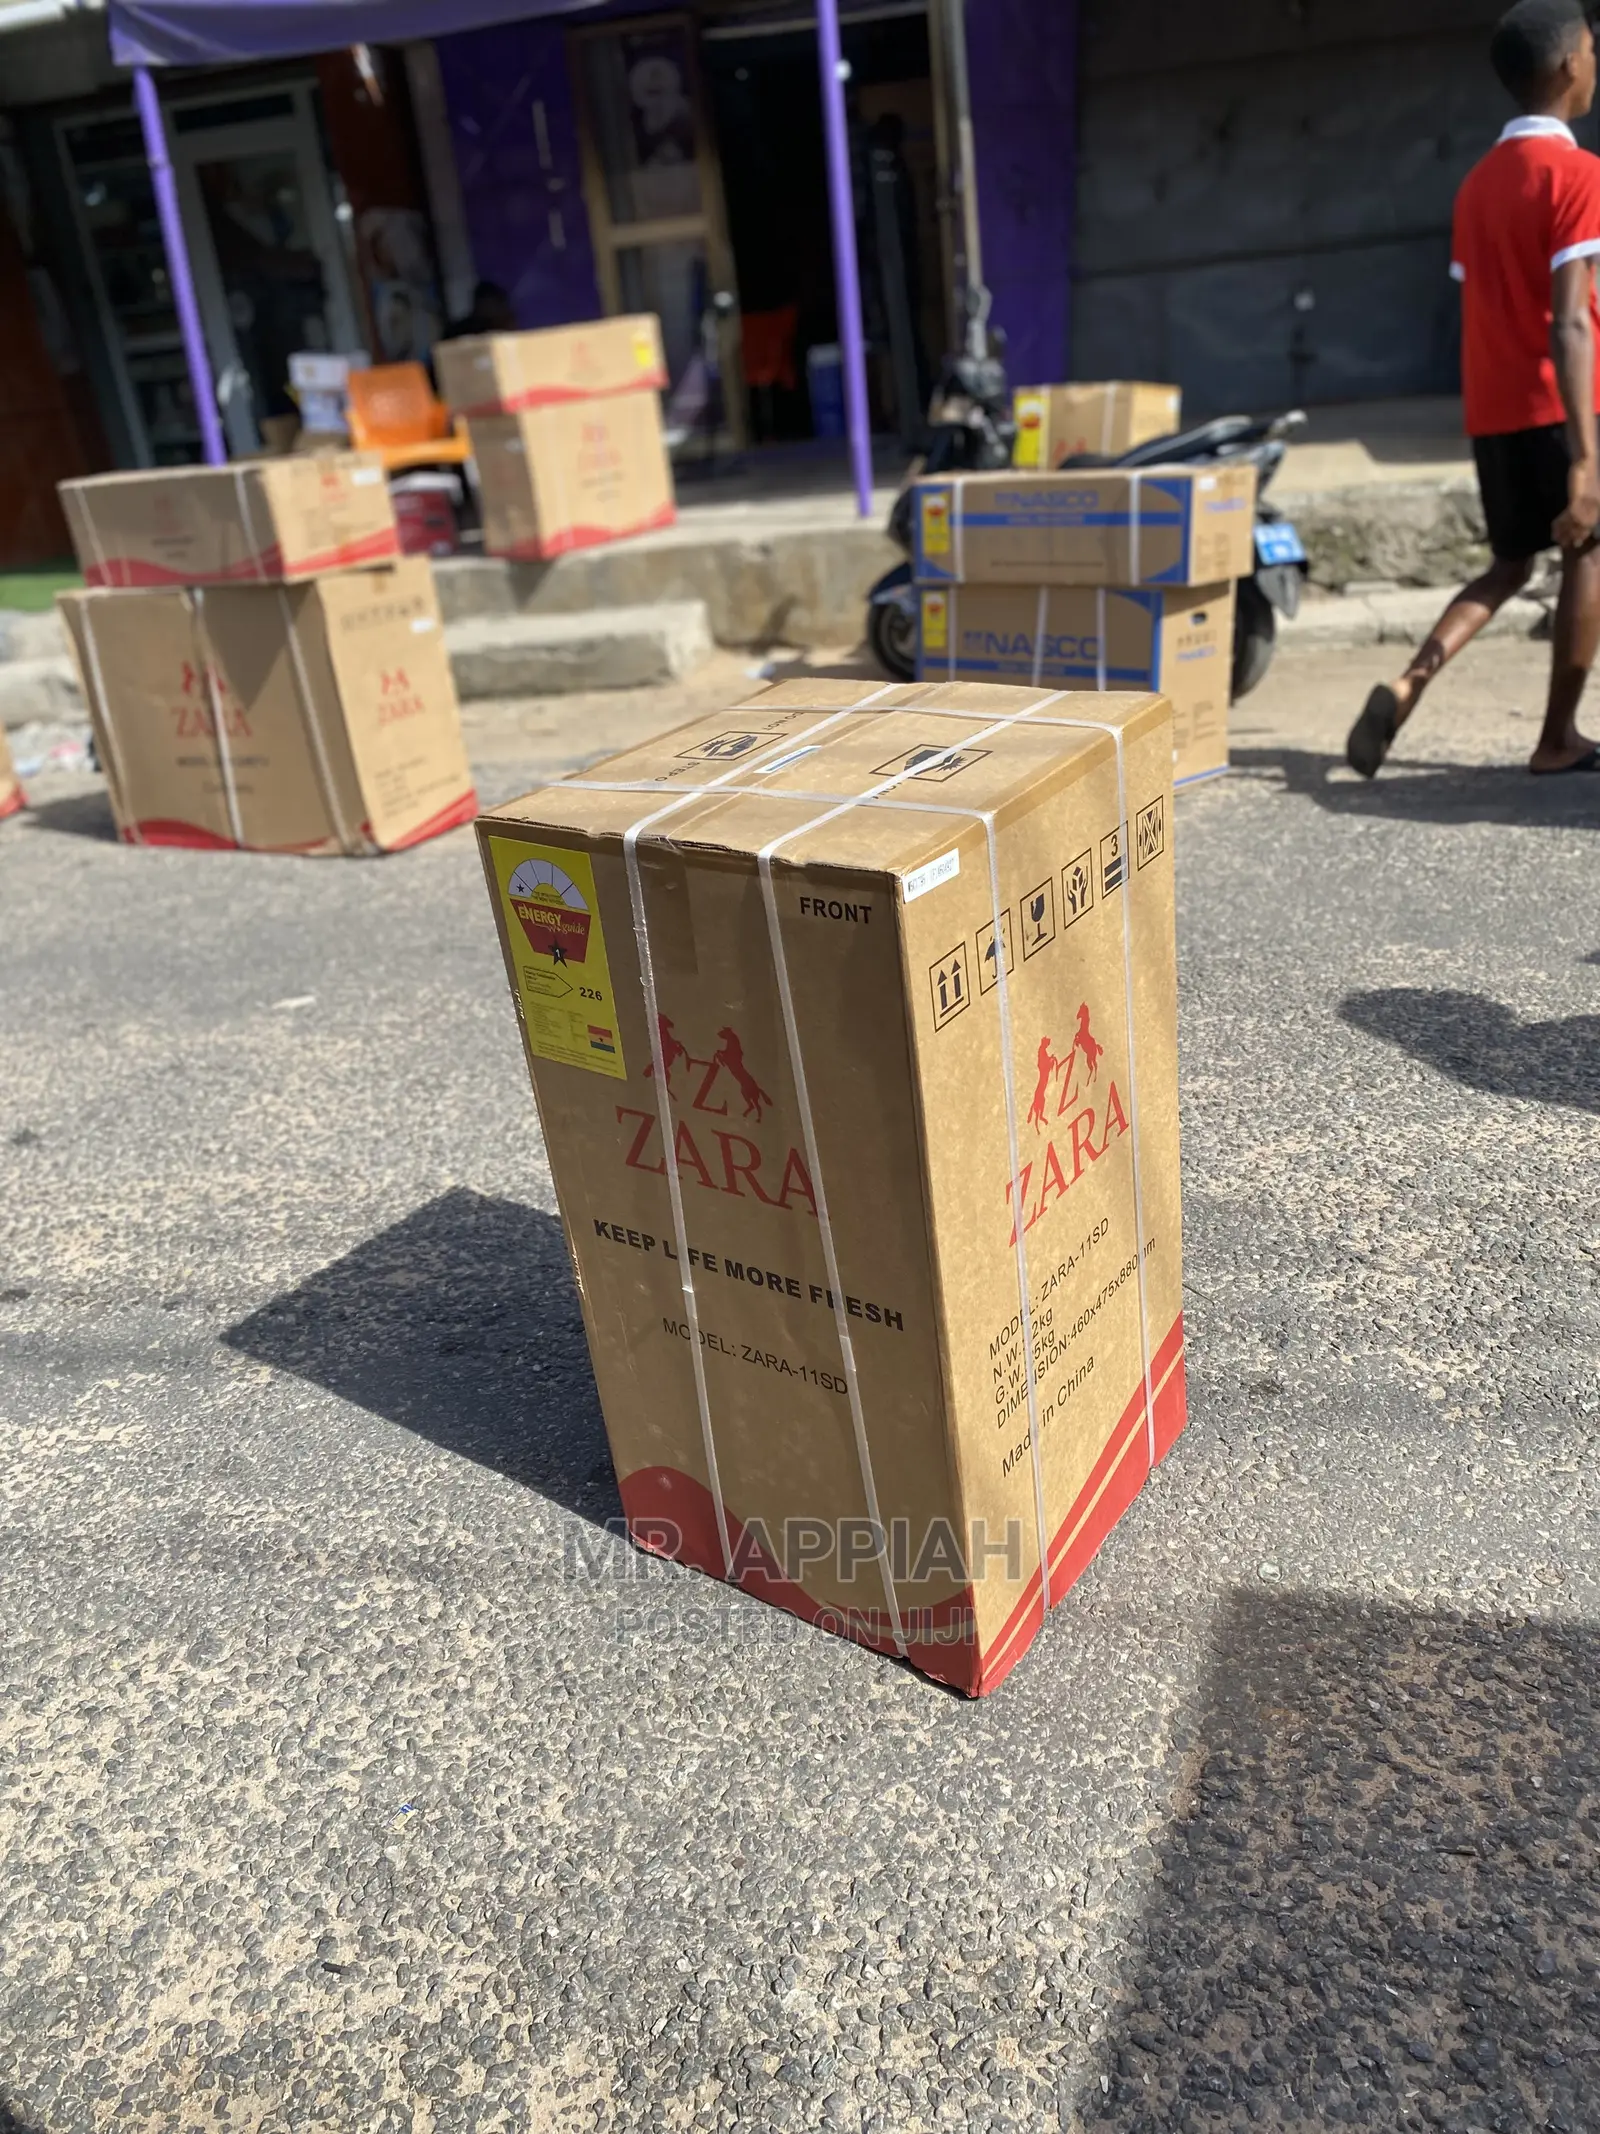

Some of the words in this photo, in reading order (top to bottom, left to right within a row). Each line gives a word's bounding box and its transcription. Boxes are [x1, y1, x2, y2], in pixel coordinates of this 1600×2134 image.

[1110, 834, 1119, 857] 3
[517, 903, 562, 927] ENERGY
[561, 921, 586, 935] guide
[800, 897, 872, 924] FRONT
[579, 986, 603, 1001] 226
[615, 1105, 831, 1222] ZARA
[1006, 1080, 1130, 1248] ZARA
[594, 1219, 656, 1251] KEEP
[662, 1239, 719, 1273] LFE
[724, 1258, 801, 1299] MORE
[1041, 1217, 1109, 1302] ZARA-11SD
[740, 1344, 848, 1395] ZARA-11SD
[1002, 1426, 1039, 1478] Mad
[1041, 1404, 1054, 1427] in
[1057, 1355, 1095, 1407] China
